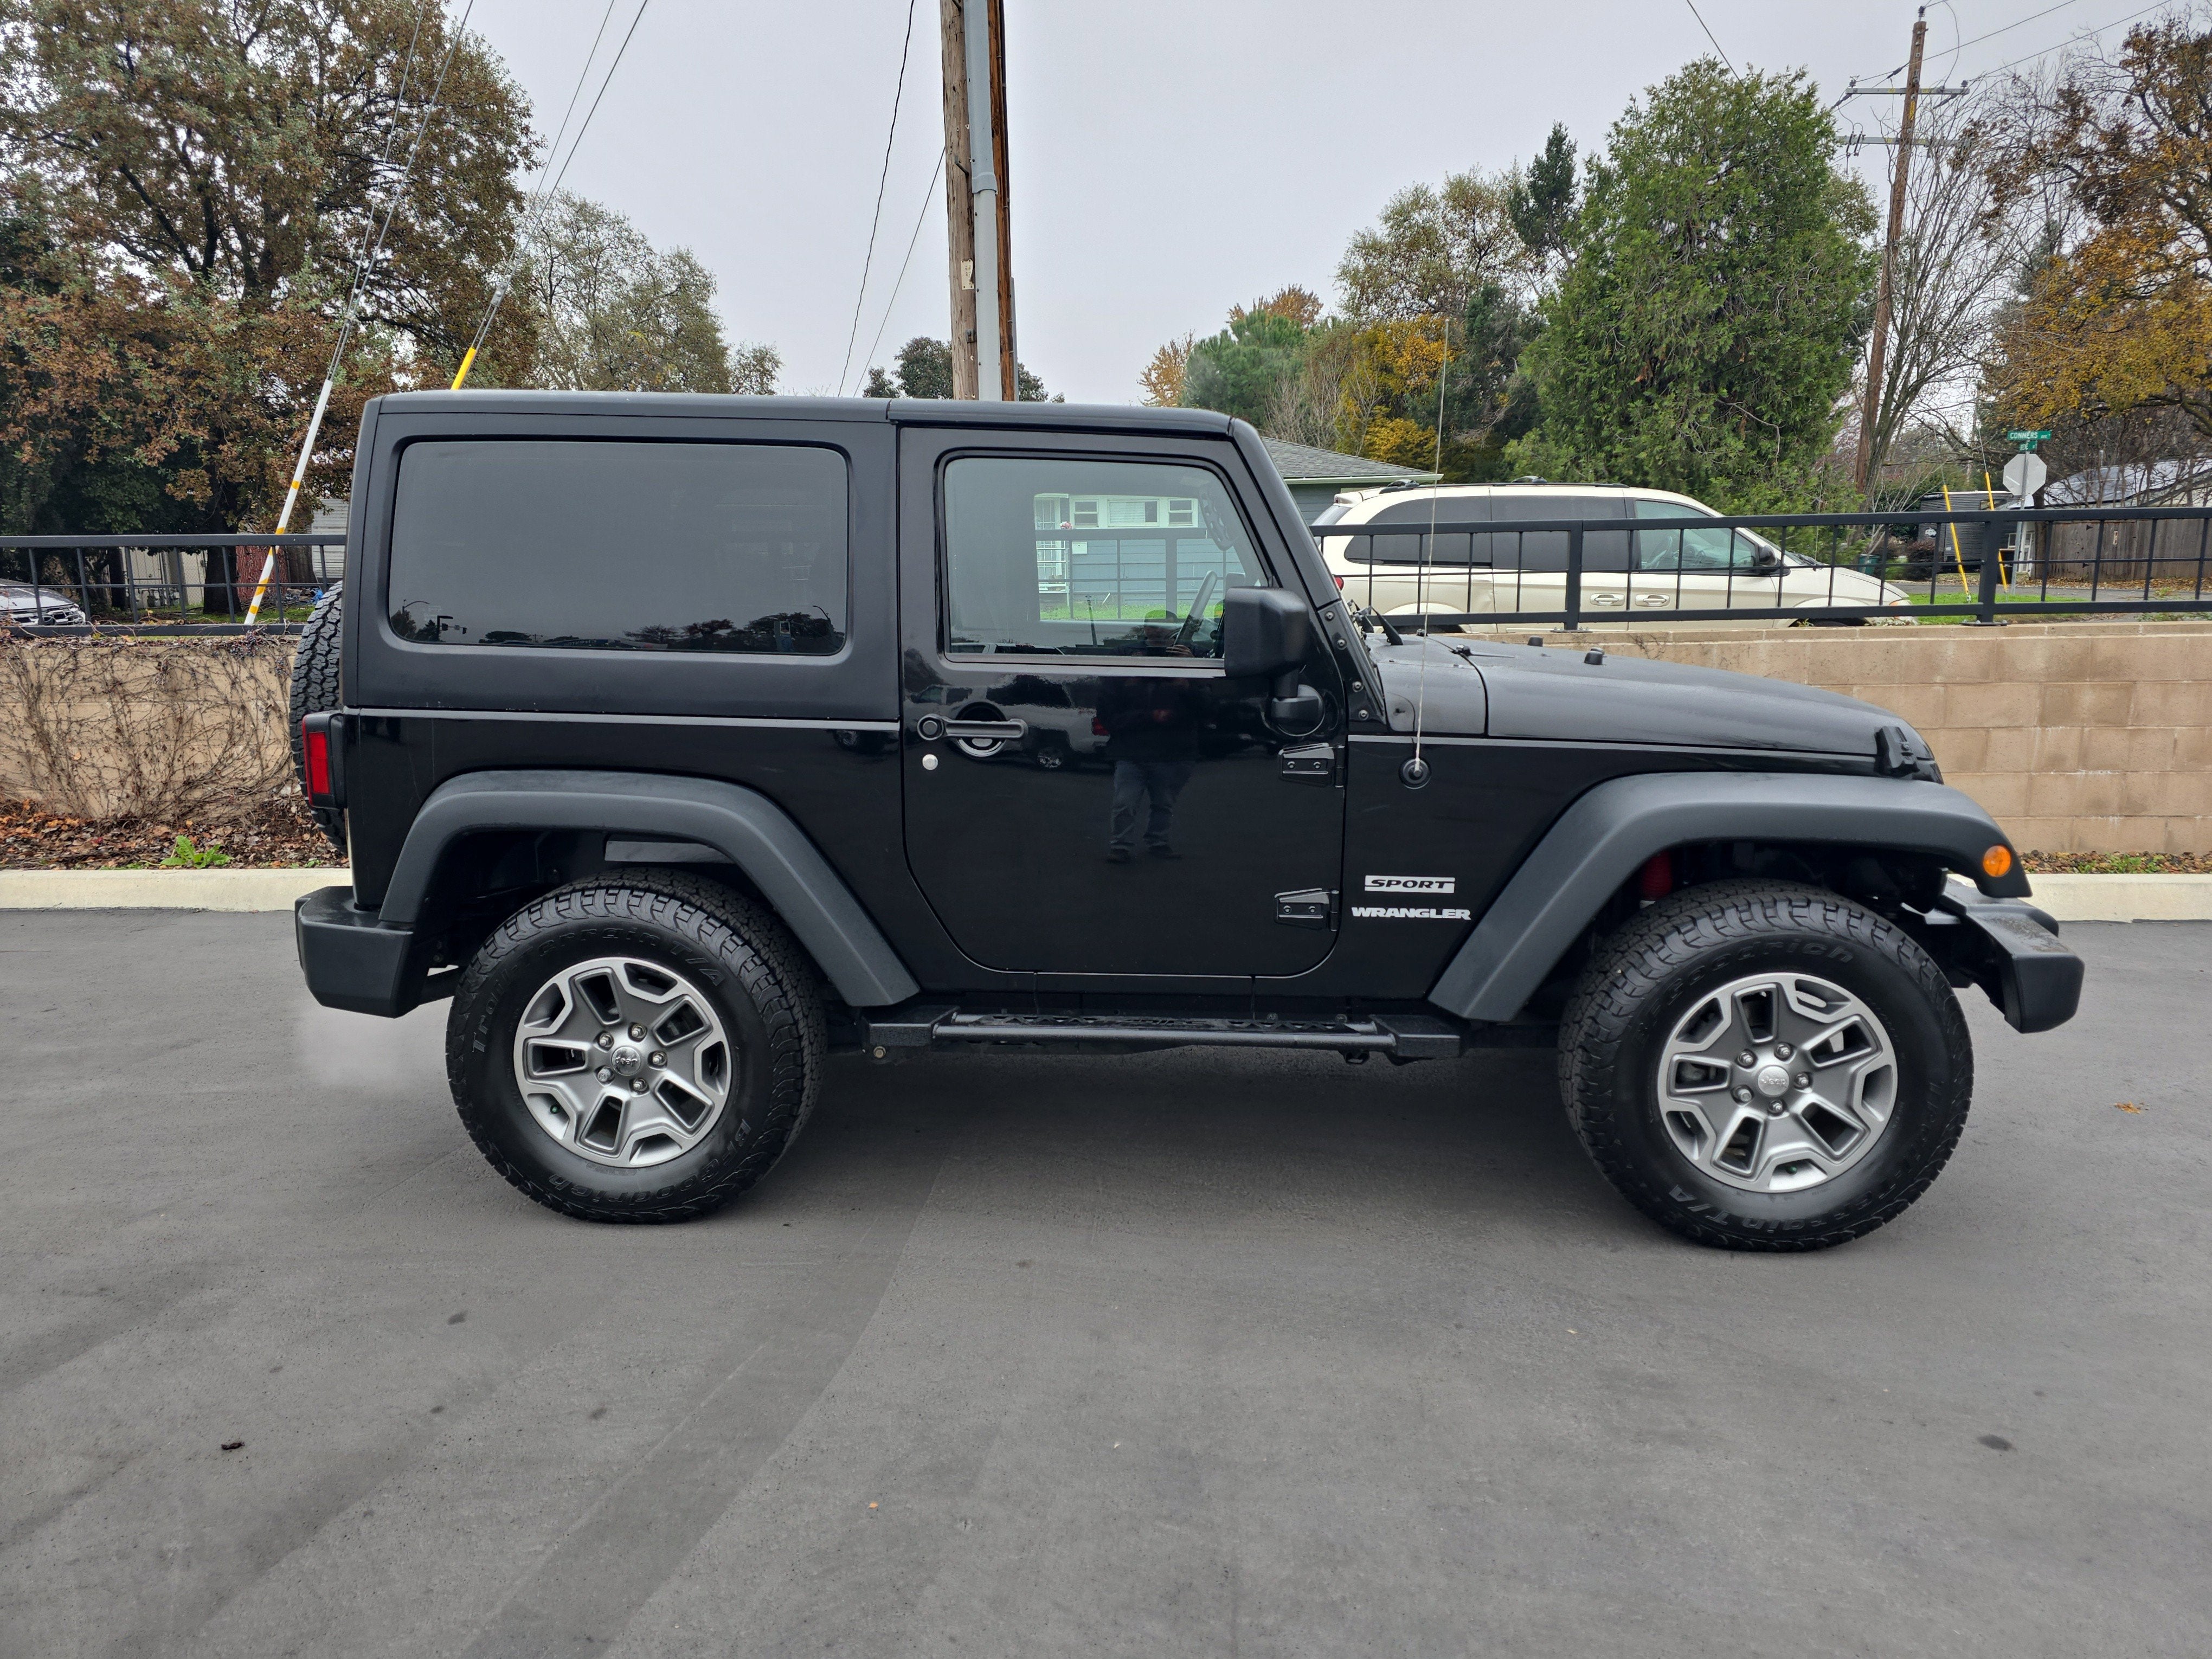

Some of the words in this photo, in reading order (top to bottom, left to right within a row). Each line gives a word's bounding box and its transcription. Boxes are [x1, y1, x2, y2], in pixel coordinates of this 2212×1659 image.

[1365, 878, 1455, 890] SPORT
[1352, 906, 1471, 920] WRANGLER
[669, 938, 725, 987] T/A
